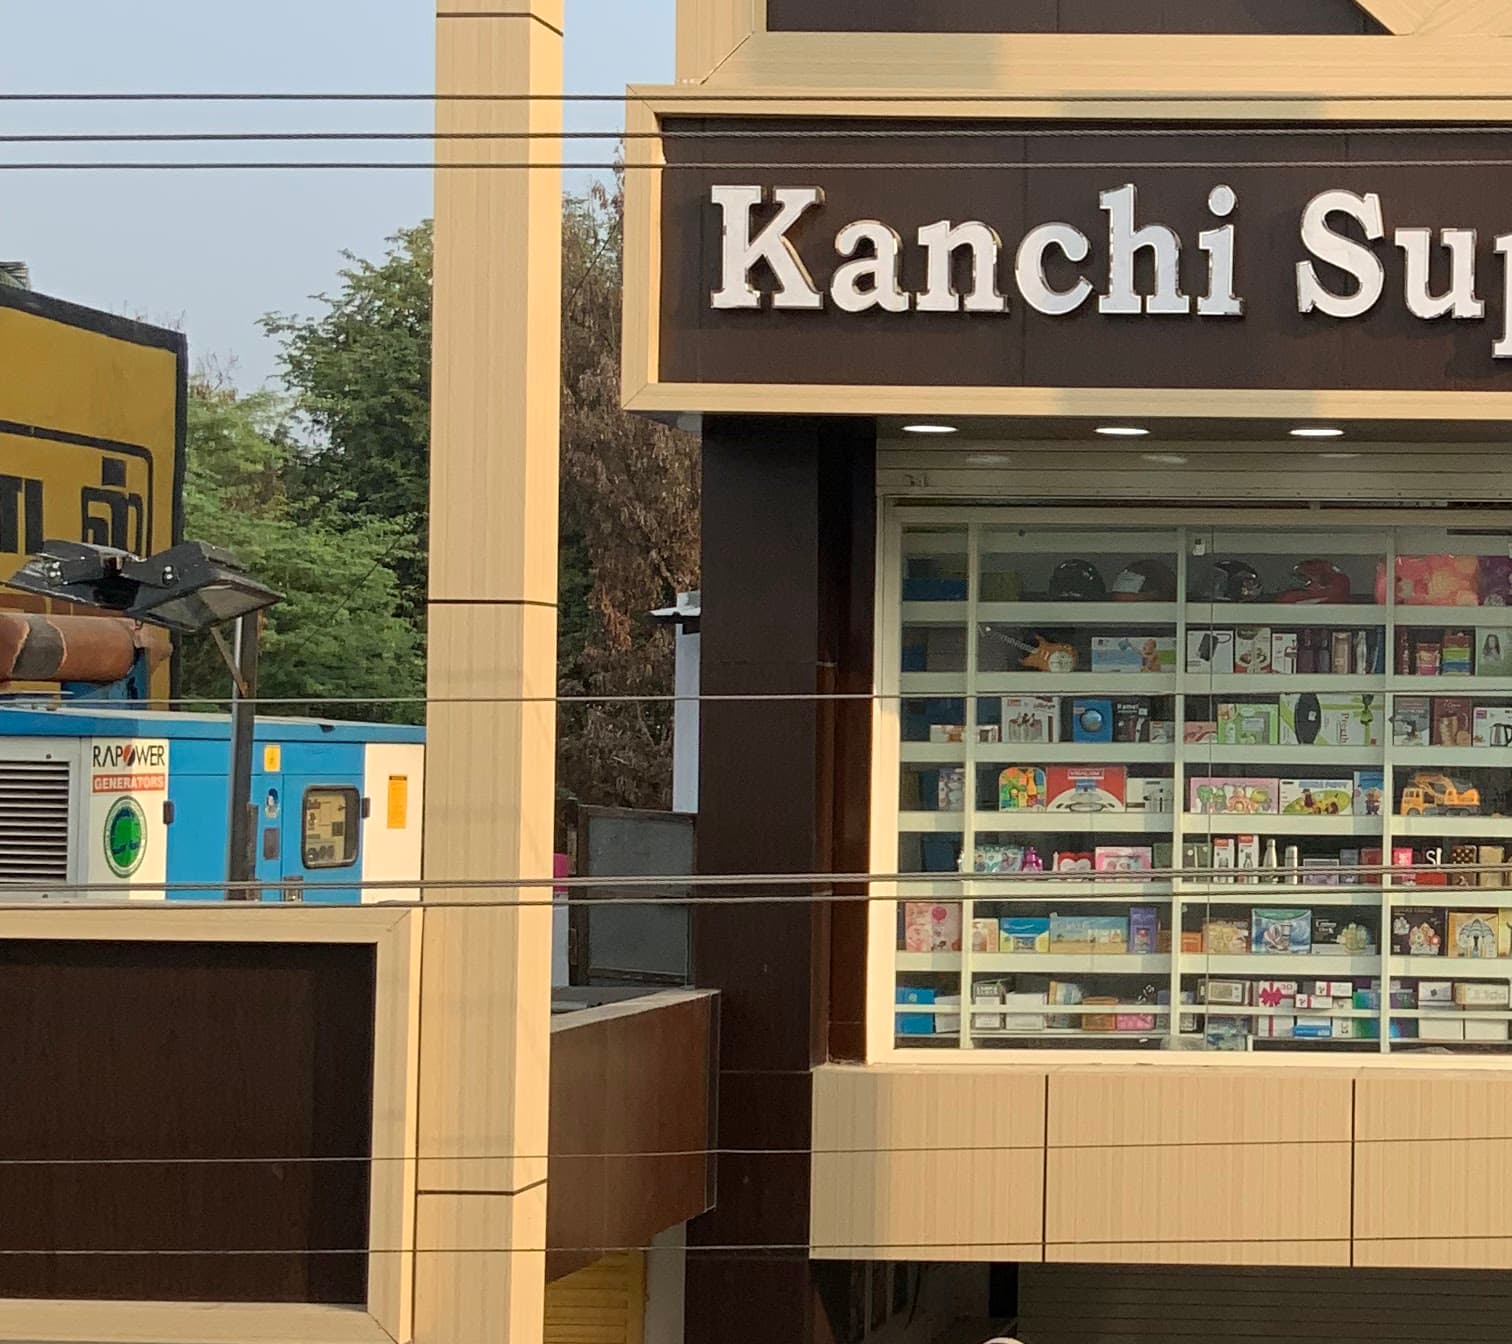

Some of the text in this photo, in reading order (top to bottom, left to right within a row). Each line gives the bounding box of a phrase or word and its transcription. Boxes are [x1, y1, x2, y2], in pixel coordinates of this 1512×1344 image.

[709, 182, 1244, 317] Kanchi
[93, 744, 165, 767] RAPOWER
[94, 775, 164, 790] GENERATORS
